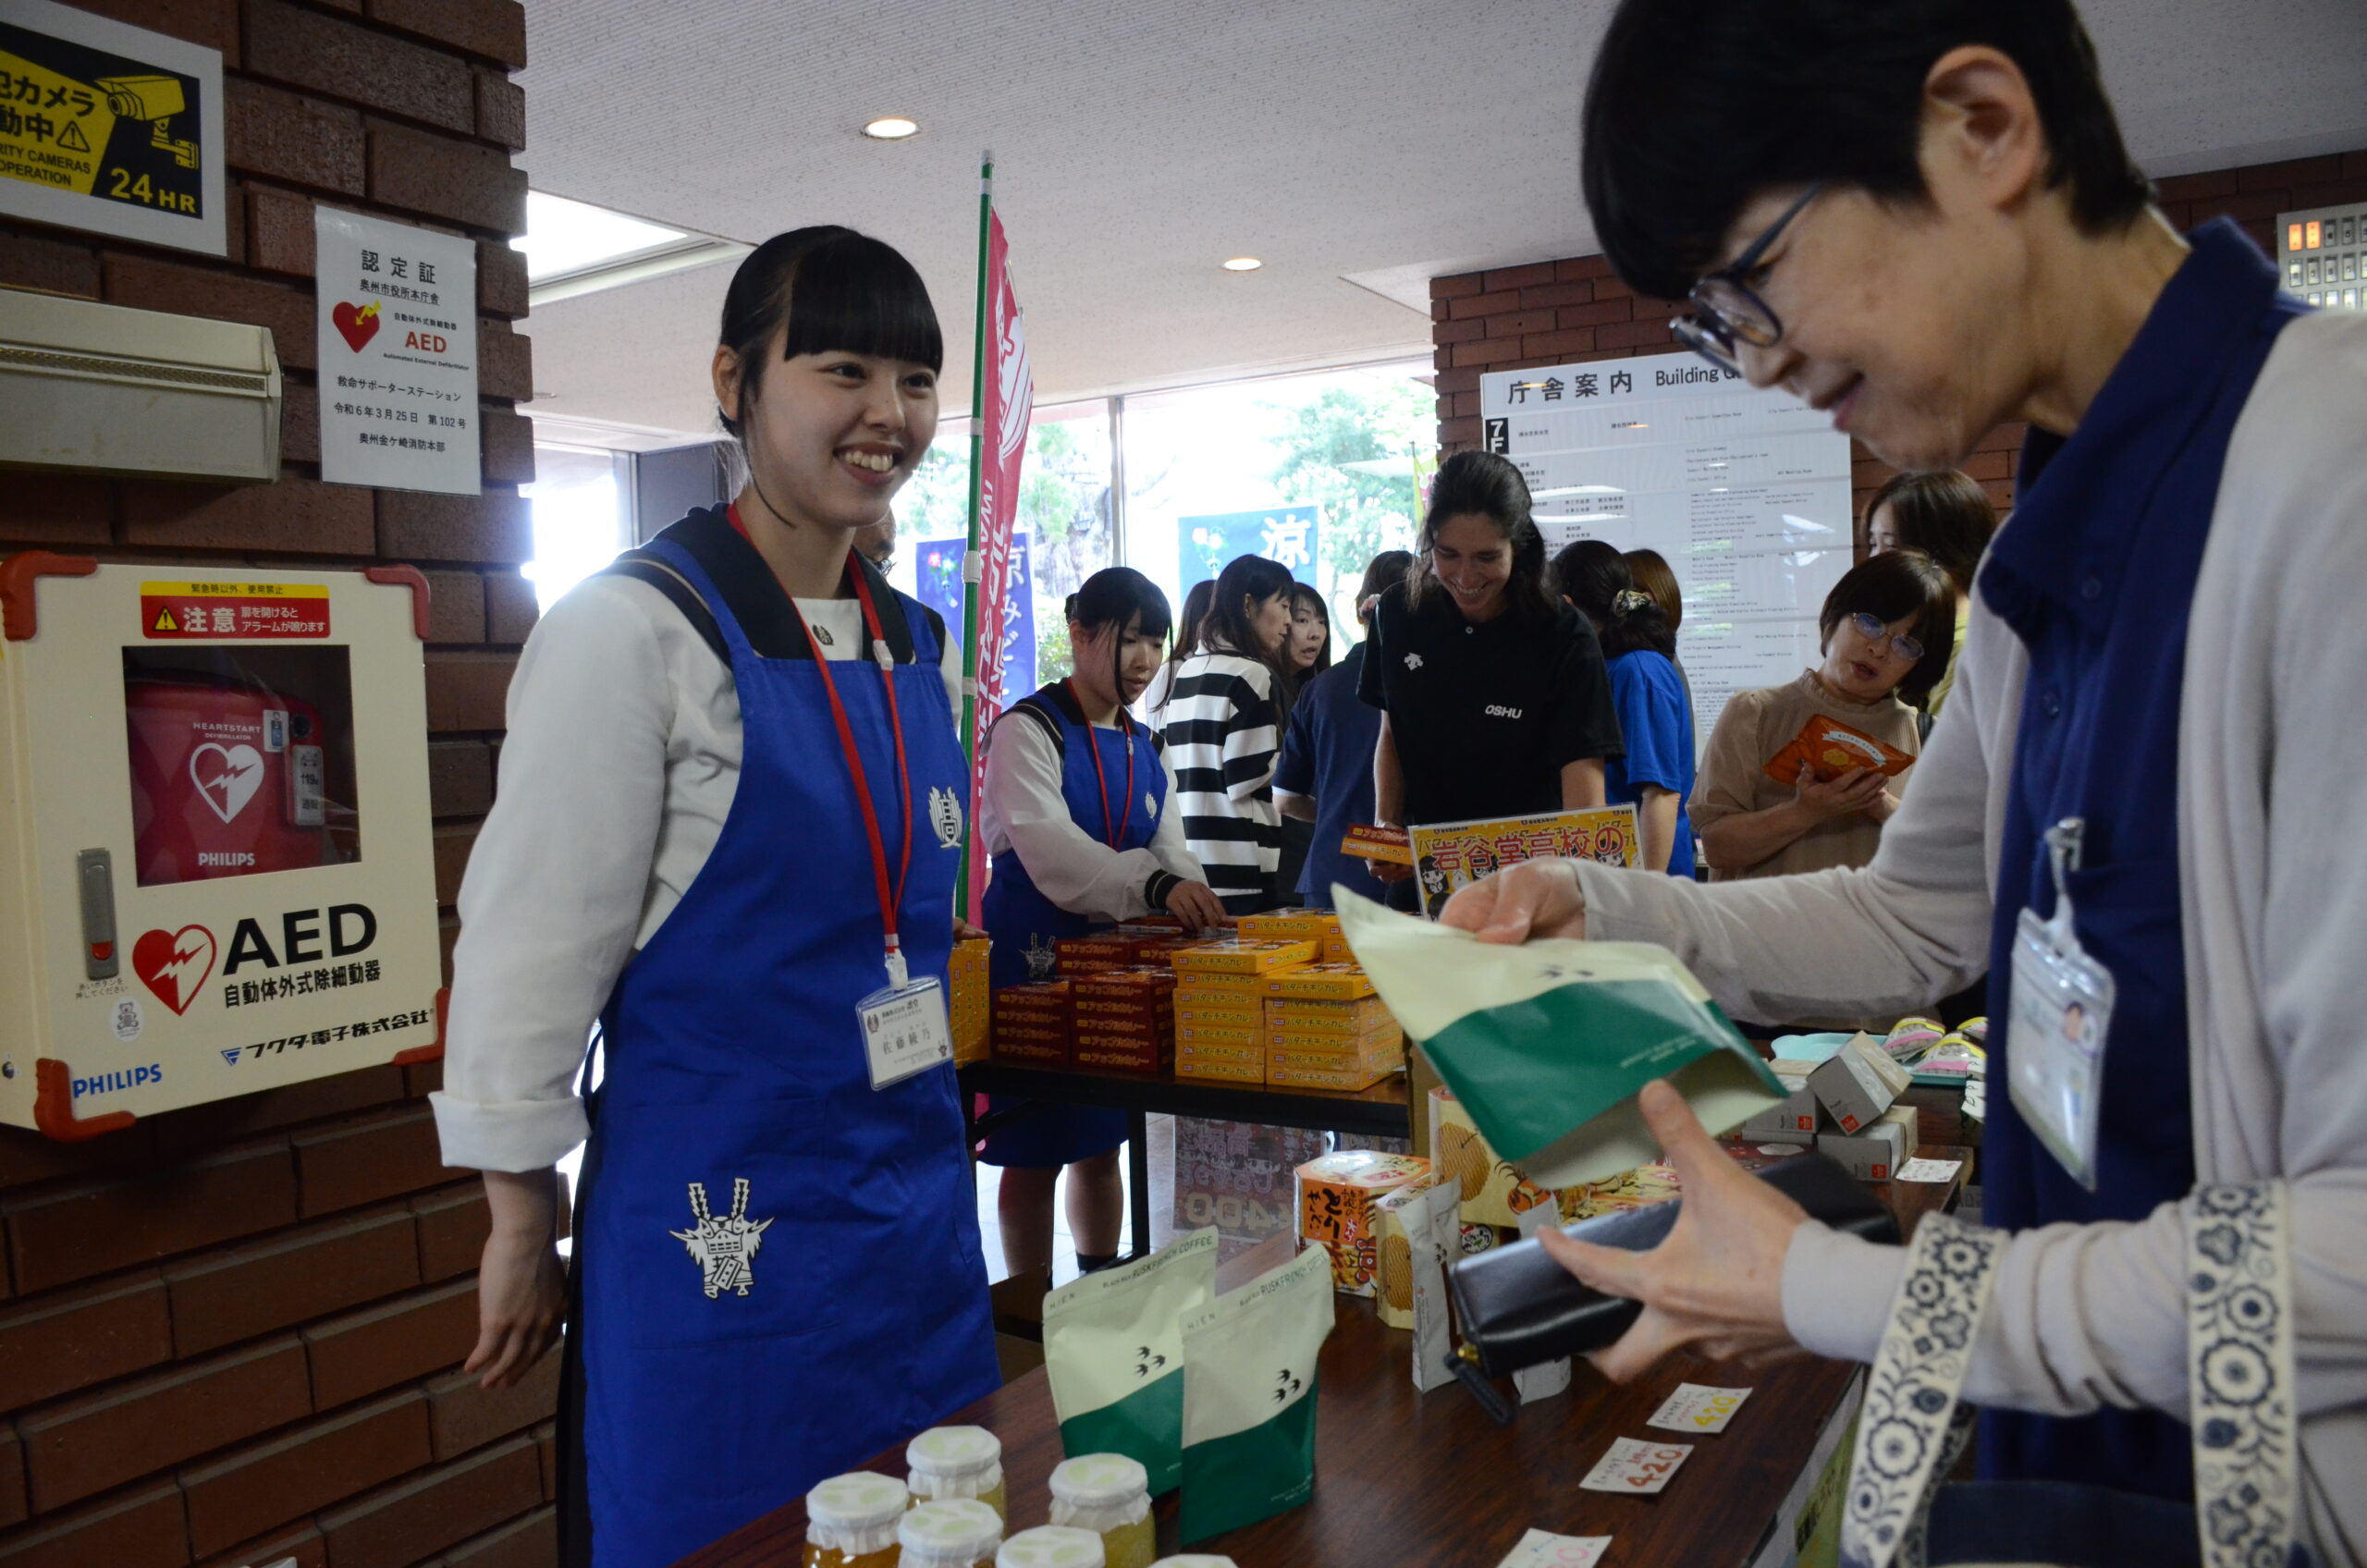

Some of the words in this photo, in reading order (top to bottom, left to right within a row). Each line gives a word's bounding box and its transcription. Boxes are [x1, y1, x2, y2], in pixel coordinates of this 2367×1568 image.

[0, 159, 71, 185] OPERATION
[28, 150, 91, 174] CAMERAS
[110, 166, 153, 204] 24
[159, 189, 196, 214] HR
[362, 250, 435, 284] 認定証
[359, 278, 439, 305] 奥州市役所本庁舎
[405, 331, 447, 353] AED
[383, 352, 413, 362] Automated
[337, 375, 461, 401] 救命サポーターステーション
[1507, 369, 1633, 405] 庁舎案内
[1655, 366, 1719, 386] Building
[334, 402, 418, 423] 令和6年3月25日
[428, 414, 466, 429] 第102号
[190, 583, 284, 594] 緊急時以外、使用禁止
[183, 606, 237, 632] 注意
[241, 606, 299, 619] 扉を開けると
[241, 621, 325, 632] アラームが鳴ります
[1484, 704, 1522, 720] OSHU
[192, 722, 262, 733] HEARTSTART
[198, 852, 256, 866] PHILIPS
[1432, 826, 1625, 872] 岩谷堂高校の
[222, 902, 378, 976] AED
[224, 960, 381, 1009] 自動体外式除細動器
[1282, 983, 1344, 993] バターチキンカレー
[245, 1011, 430, 1059] フクダ電子株式会社
[72, 1063, 163, 1099] PHILIPS
[1178, 1235, 1213, 1255] COFFEE
[1260, 1280, 1281, 1296] RUSK
[1693, 1396, 1738, 1427] 420
[1626, 1449, 1683, 1488] 420
